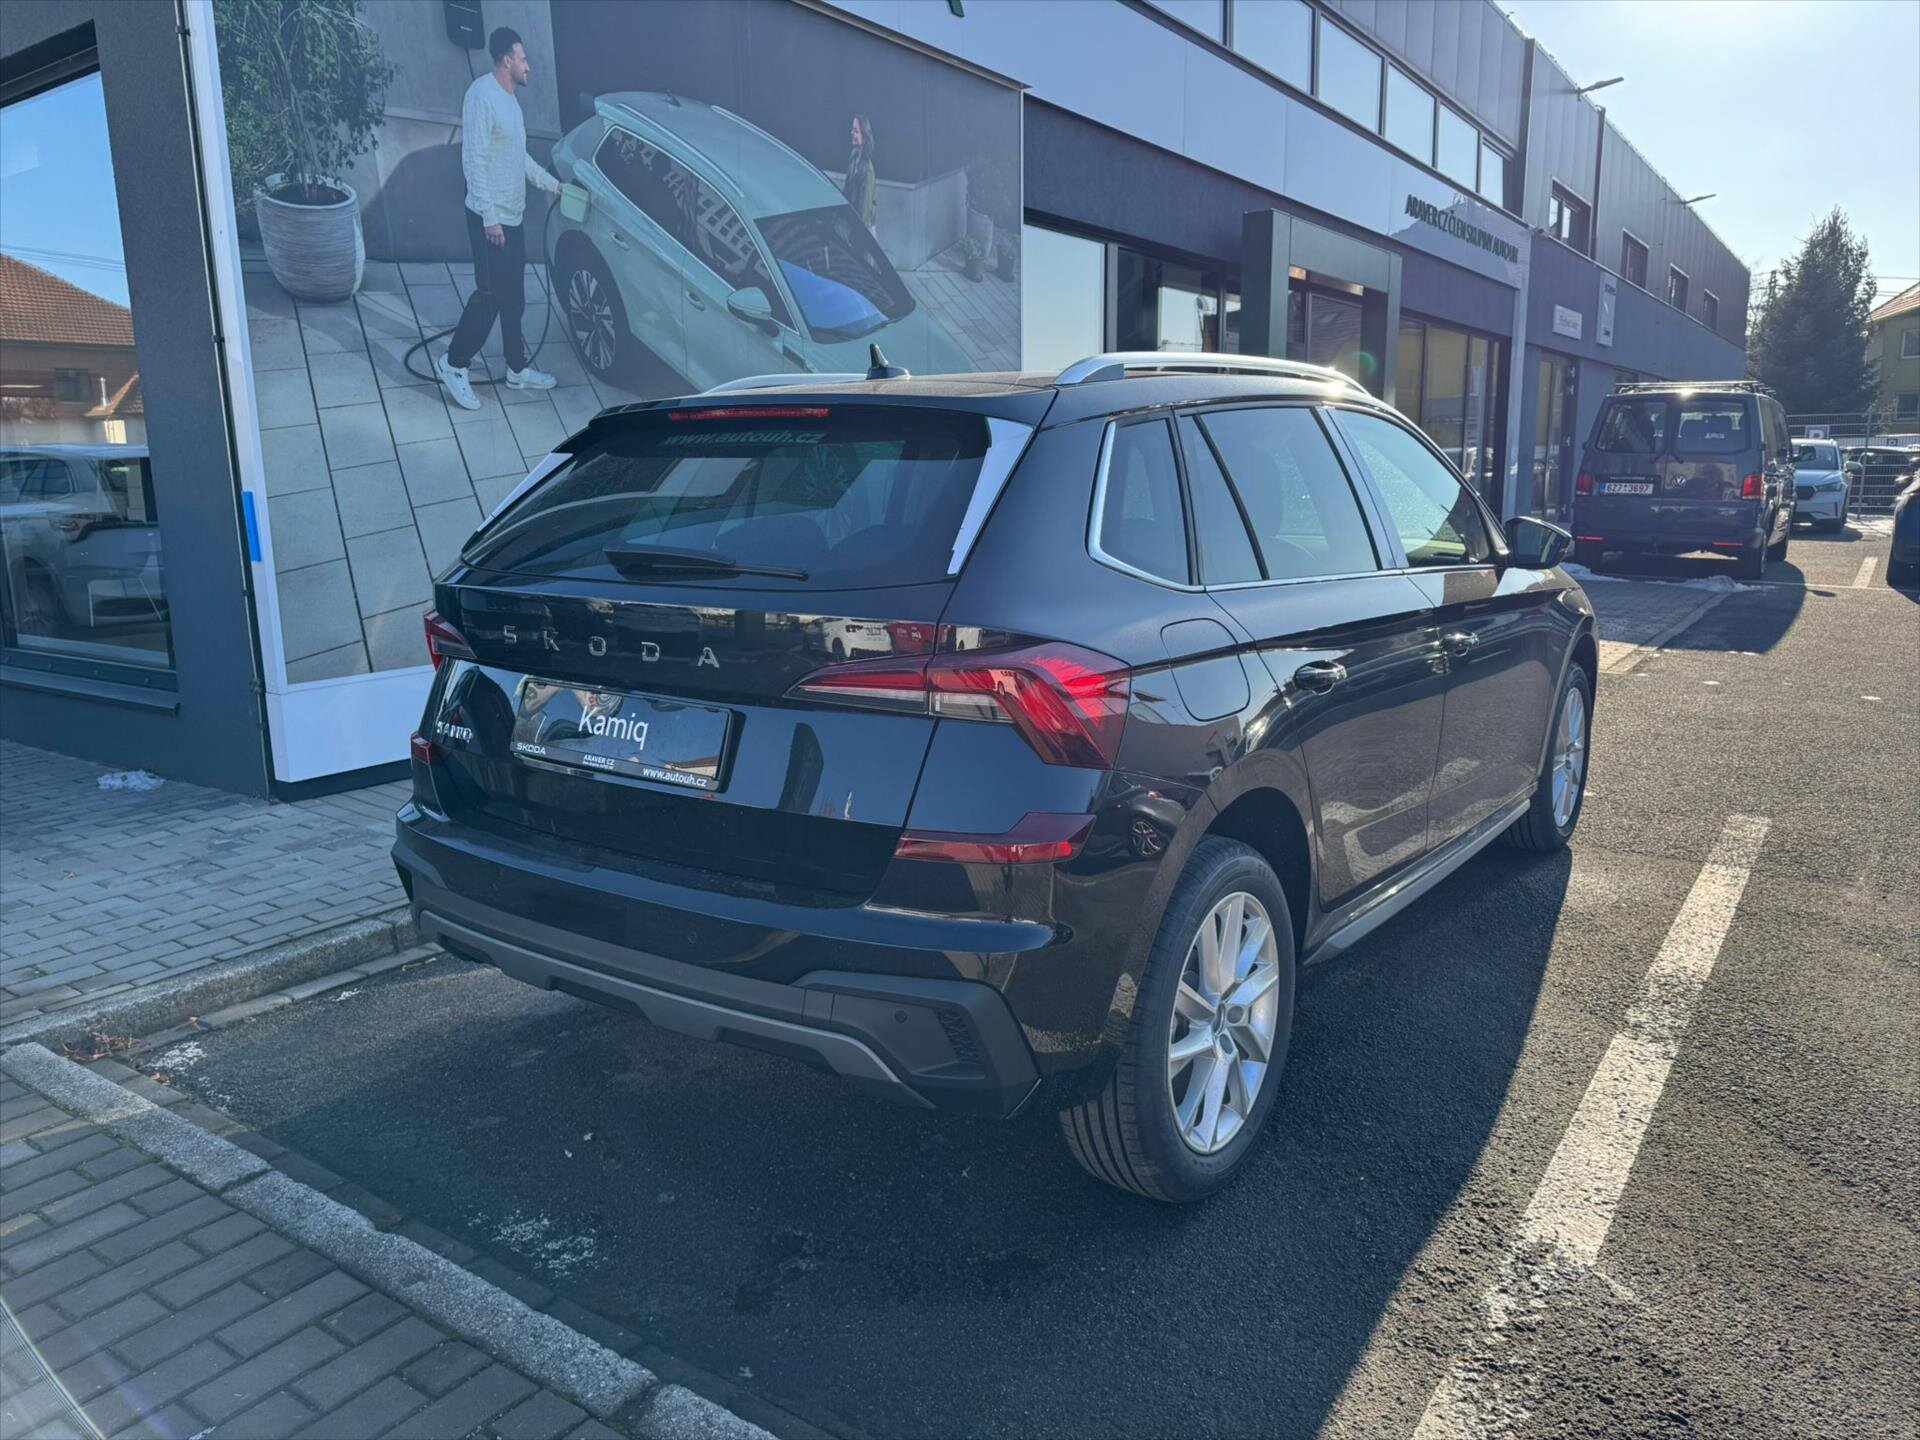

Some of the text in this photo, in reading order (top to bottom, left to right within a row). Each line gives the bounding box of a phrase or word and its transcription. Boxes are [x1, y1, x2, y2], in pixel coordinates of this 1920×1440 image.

[665, 430, 826, 446] www.autouh.cz
[578, 706, 649, 750] Kamiq
[583, 754, 606, 765] ARAVER
[643, 767, 707, 788] www.autouh.cz
